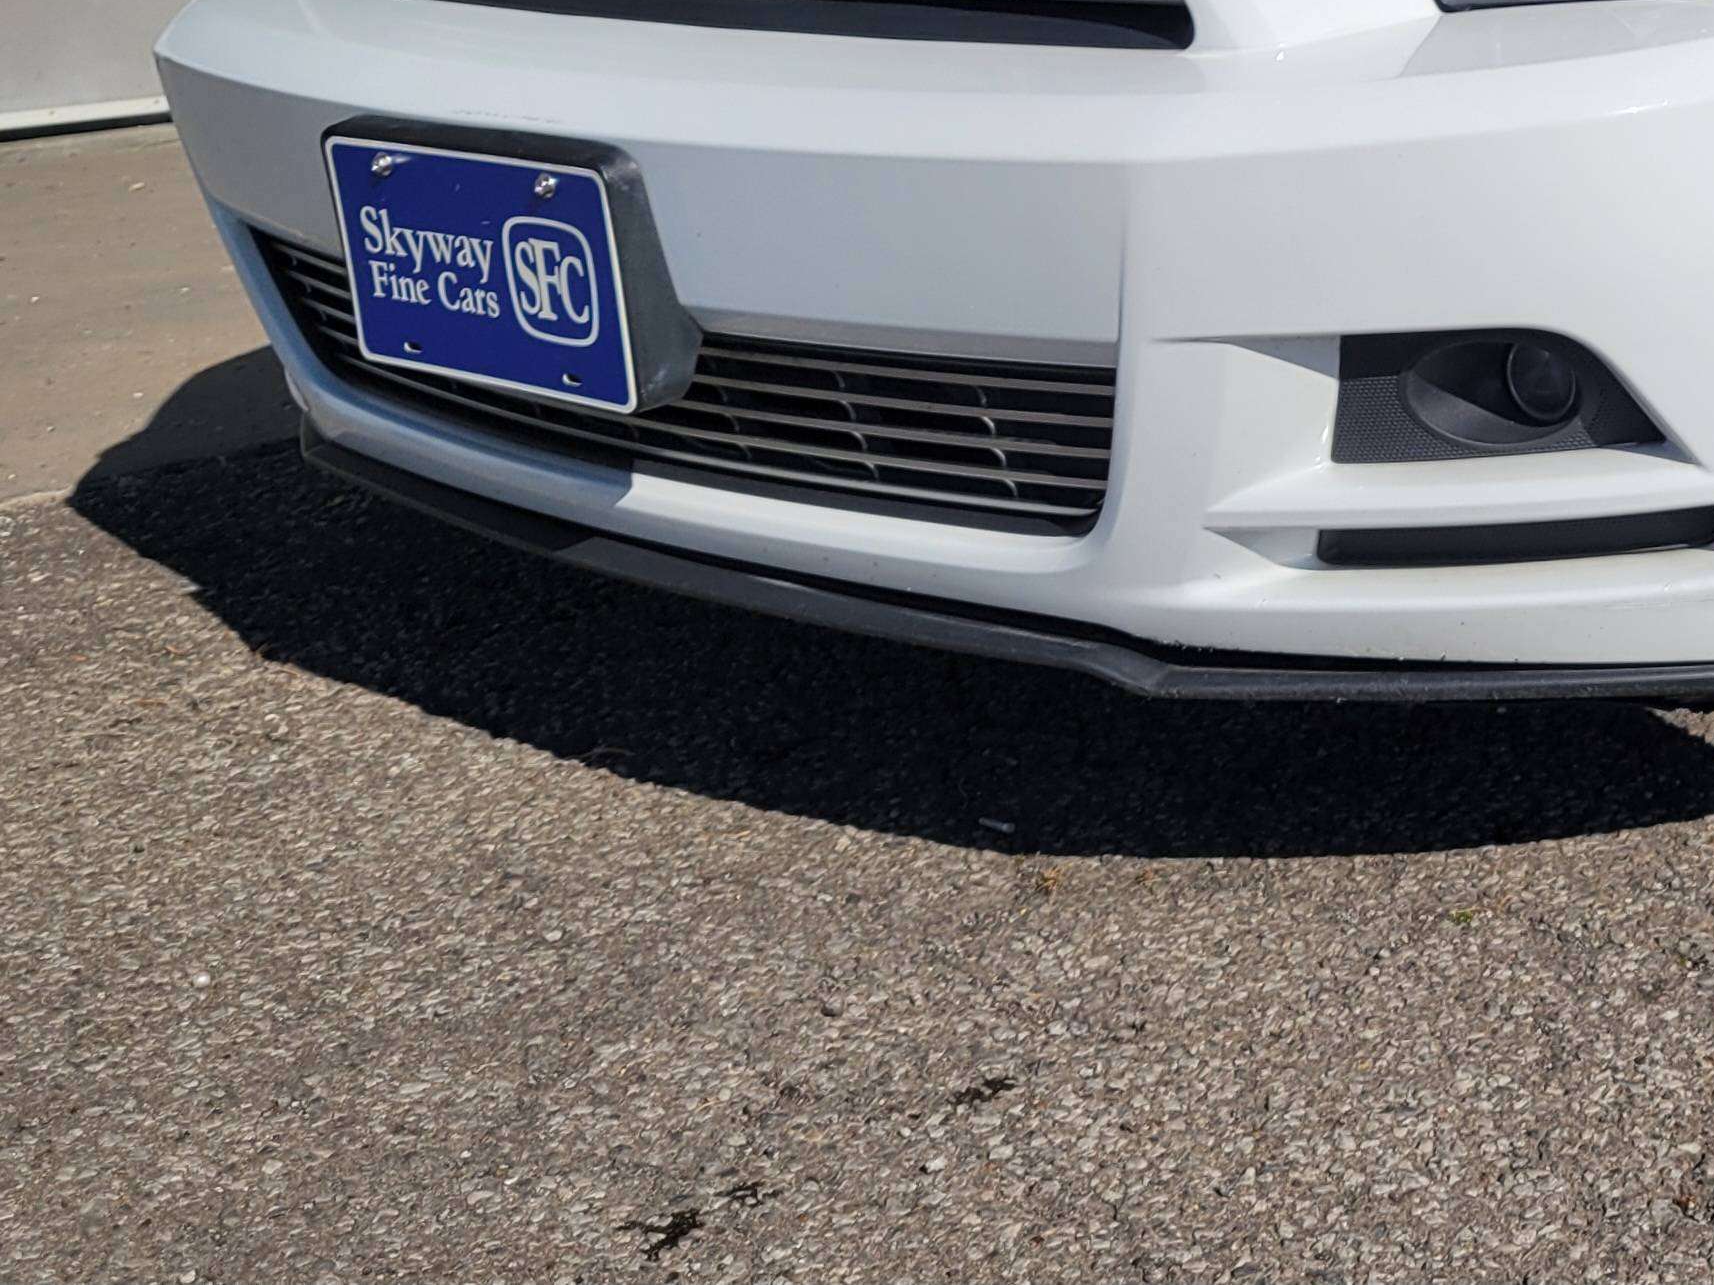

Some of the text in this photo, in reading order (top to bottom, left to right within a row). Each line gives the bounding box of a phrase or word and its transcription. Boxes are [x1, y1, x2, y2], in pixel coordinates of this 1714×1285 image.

[359, 205, 494, 284] Skyway
[514, 237, 590, 324] SFC
[368, 260, 500, 318] Fine Cars
